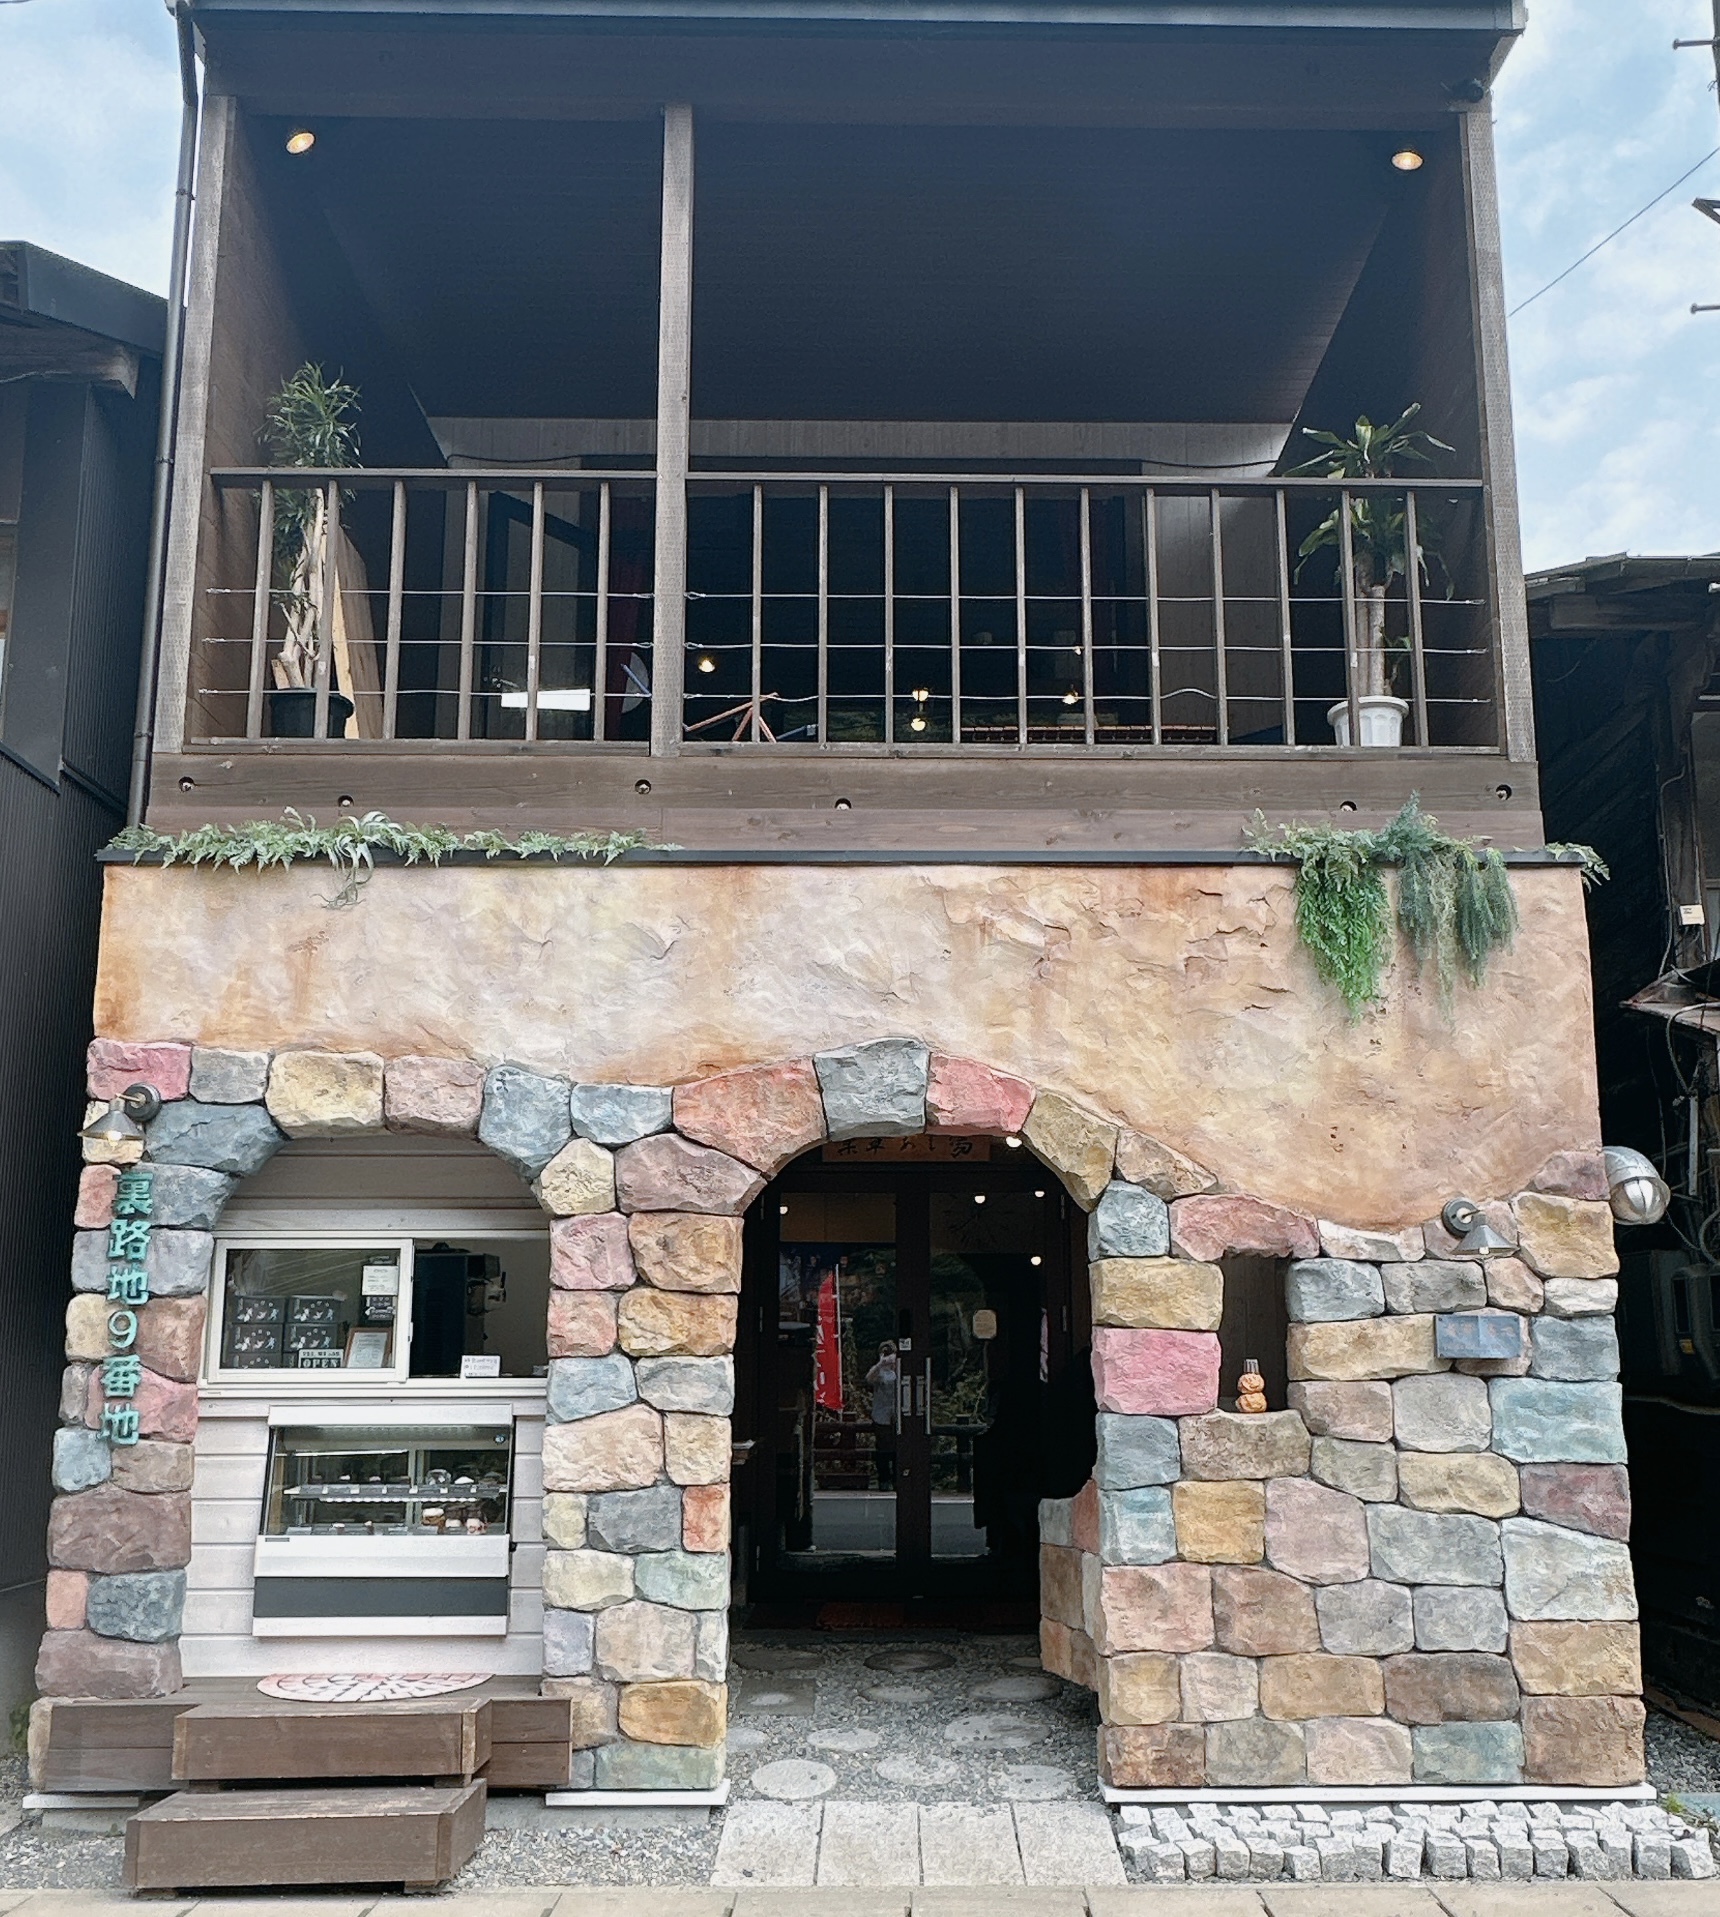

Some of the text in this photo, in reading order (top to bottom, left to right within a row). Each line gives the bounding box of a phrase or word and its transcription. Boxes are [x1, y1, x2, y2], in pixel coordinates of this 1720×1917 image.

[98, 1172, 153, 1445] 裏路地9番地
[303, 1358, 339, 1368] OPEN
